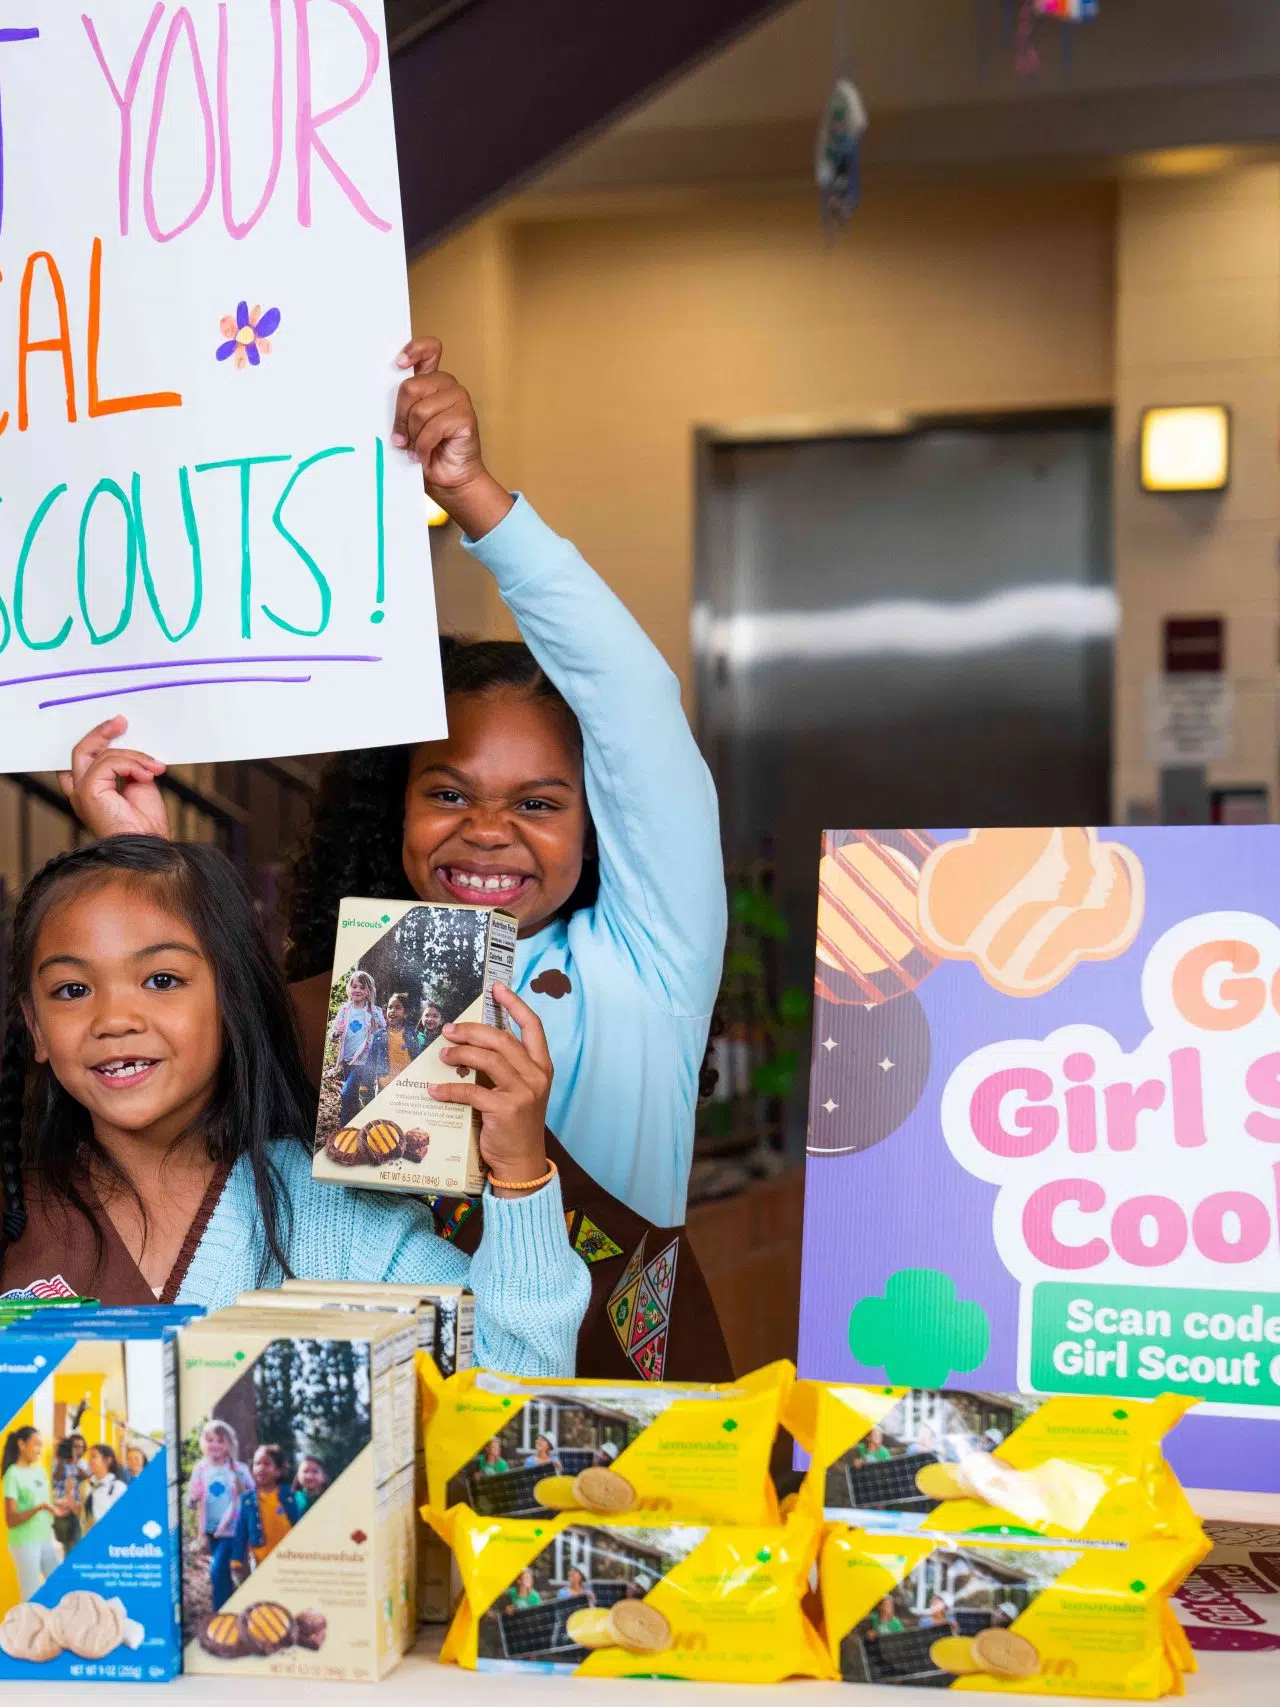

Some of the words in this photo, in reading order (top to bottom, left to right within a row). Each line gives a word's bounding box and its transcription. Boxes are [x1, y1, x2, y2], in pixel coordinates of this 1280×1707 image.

[82, 0, 392, 243] YOUR
[341, 917, 356, 929] girl
[356, 919, 382, 929] scouts
[1172, 938, 1280, 1032] G
[396, 1078, 430, 1089] advent
[969, 1046, 1207, 1158] Girl
[380, 1172, 390, 1180] NET
[413, 1174, 421, 1183] OZ
[1021, 1161, 1280, 1270] Coo
[1066, 1300, 1170, 1338] Scan
[1053, 1340, 1128, 1378] Girl
[1136, 1346, 1260, 1386] Scout
